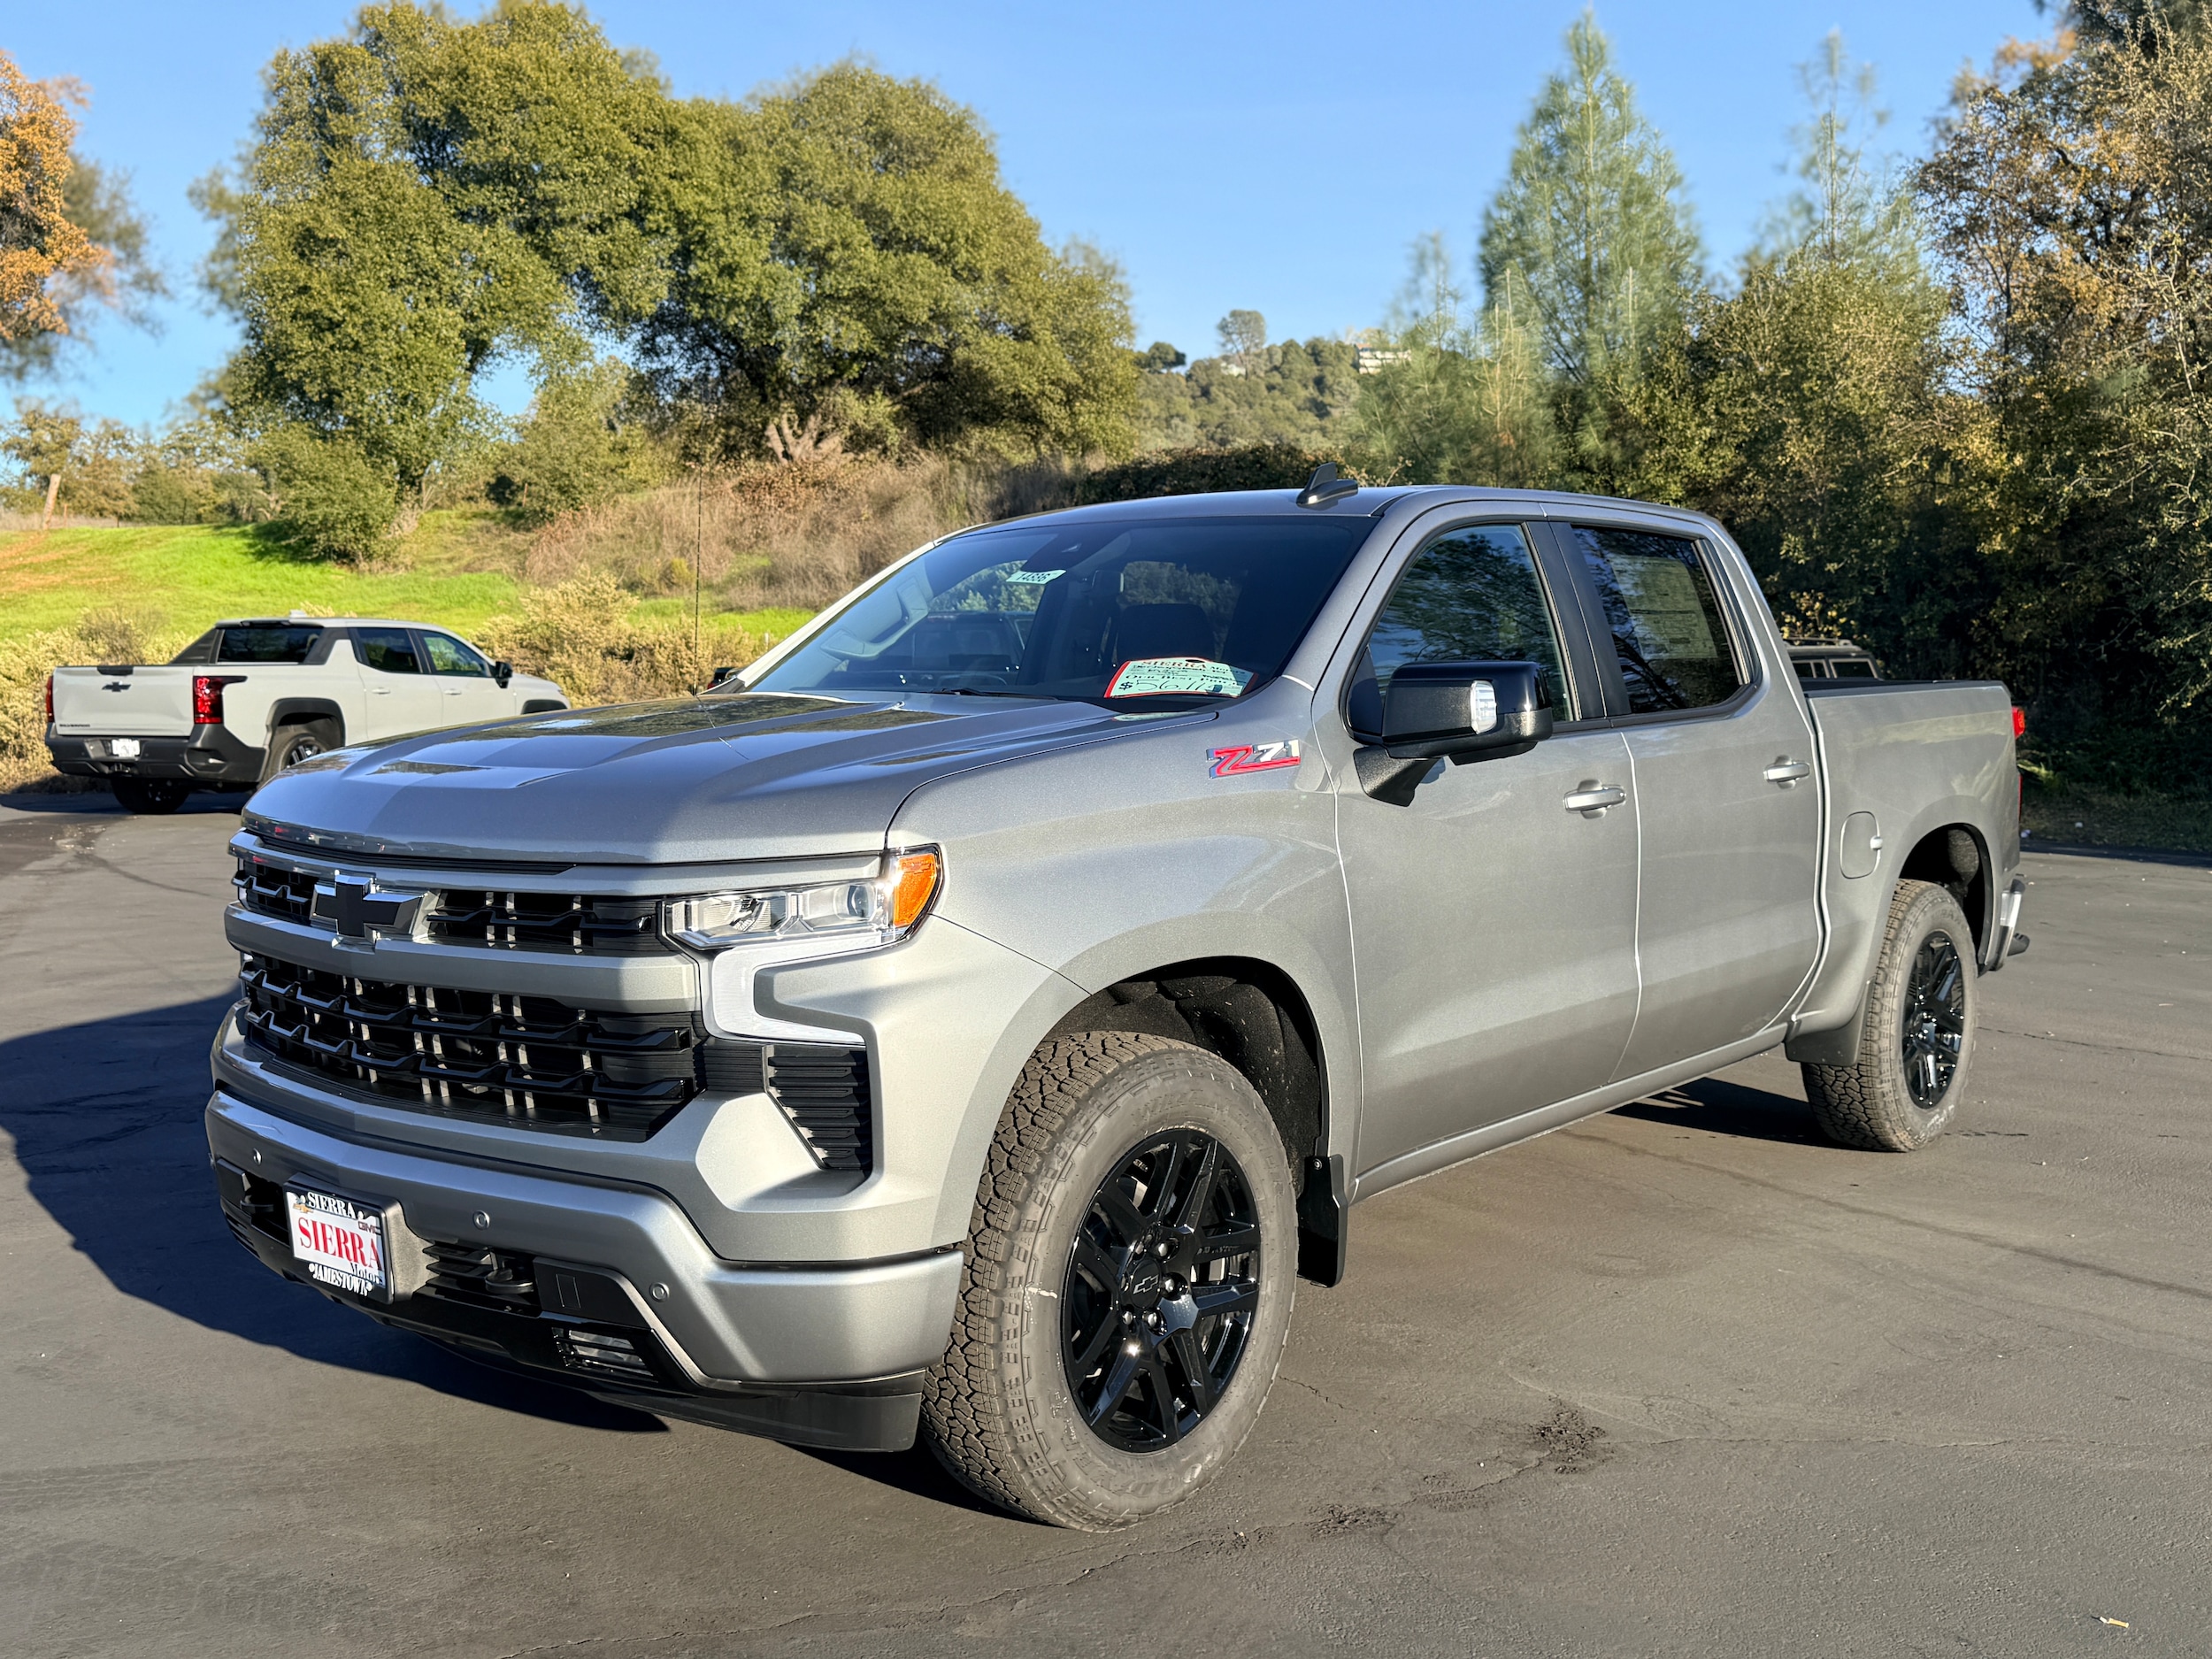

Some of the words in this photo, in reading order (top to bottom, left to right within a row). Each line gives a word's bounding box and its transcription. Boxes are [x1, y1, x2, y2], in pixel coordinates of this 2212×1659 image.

[1206, 739, 1301, 779] Z71
[307, 1191, 356, 1218] SIERRA
[298, 1217, 382, 1271] SIERRA
[312, 1263, 369, 1297] JAMESTOWN
